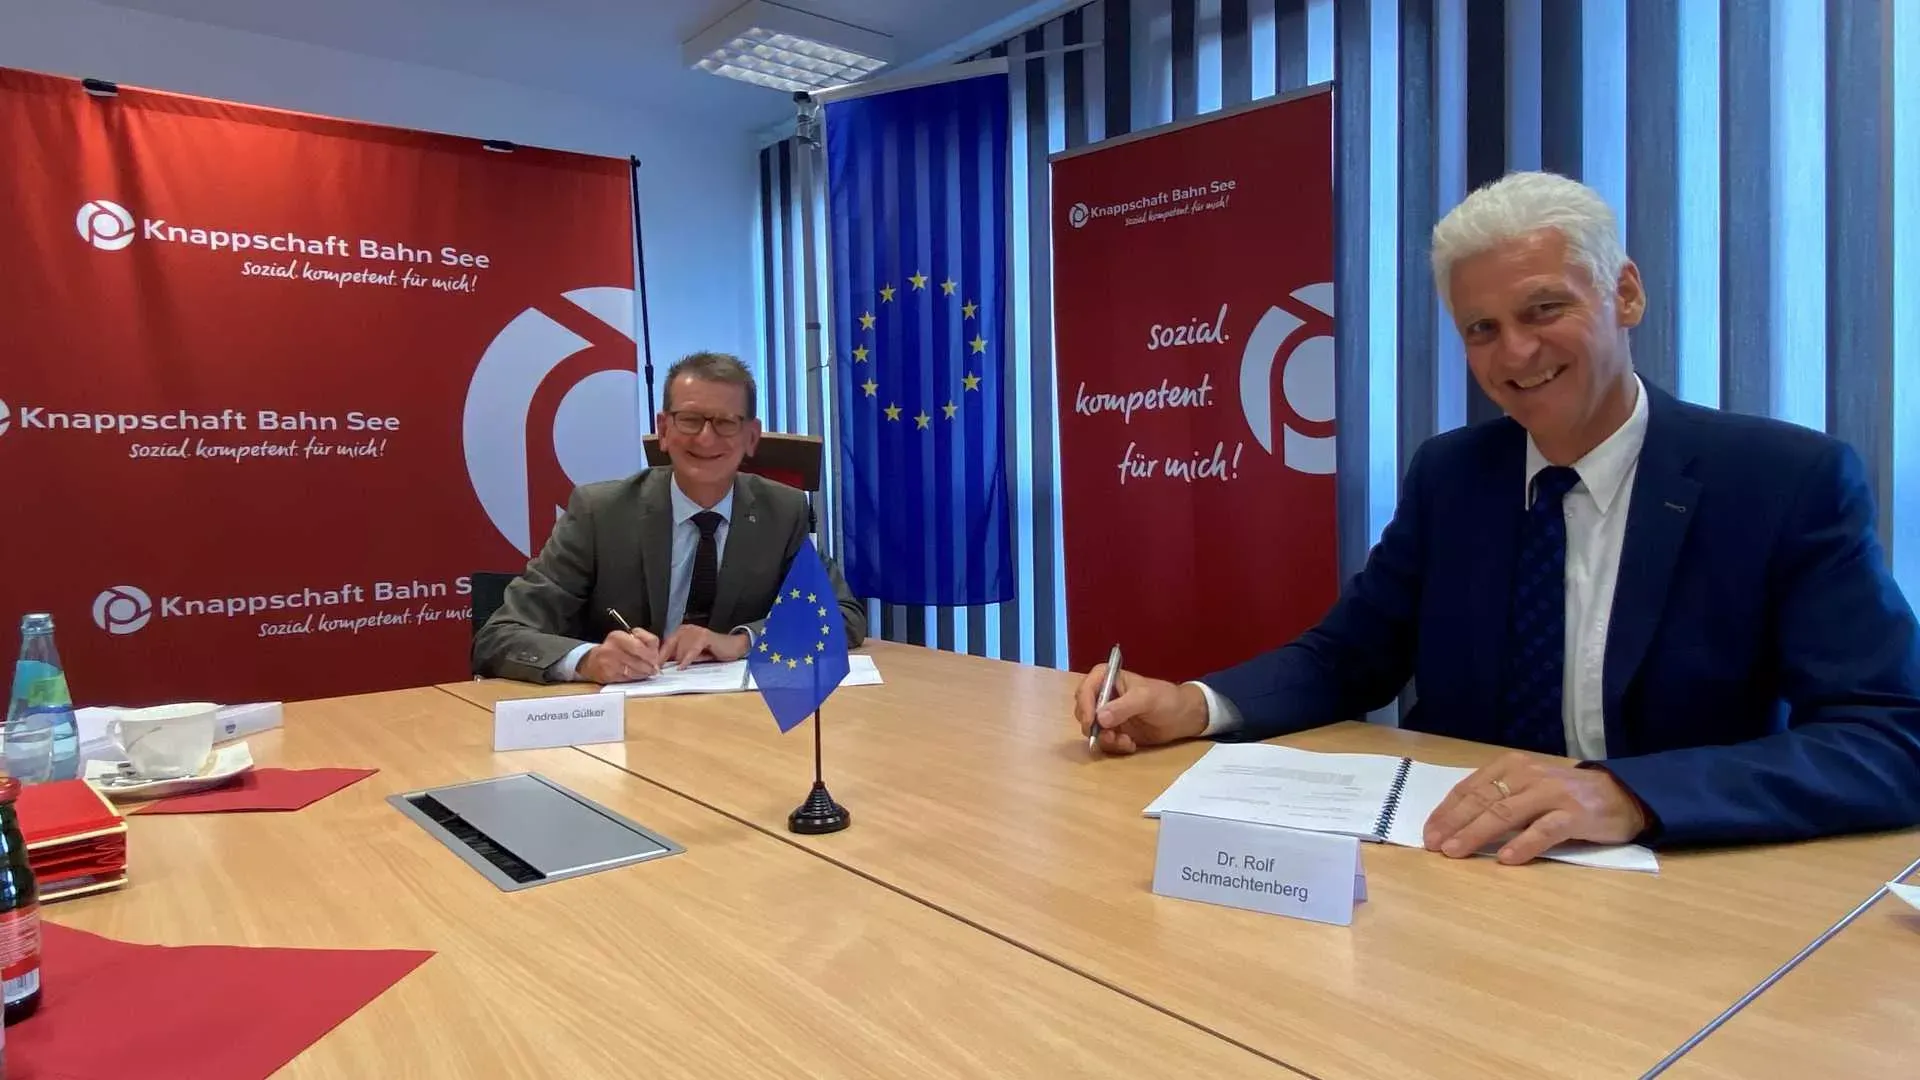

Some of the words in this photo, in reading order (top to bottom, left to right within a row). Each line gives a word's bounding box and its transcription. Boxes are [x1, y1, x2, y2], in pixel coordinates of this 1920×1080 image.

[1090, 191, 1169, 218] Knappschaft
[1172, 186, 1207, 201] Bahn
[1210, 180, 1237, 193] See
[143, 218, 350, 257] Knappschaft
[359, 239, 433, 263] Bahn
[440, 247, 490, 268] See
[402, 268, 429, 289] für
[432, 274, 478, 293] mich!
[1147, 303, 1230, 350] sozial.
[1075, 373, 1213, 424] kompetent.
[20, 406, 247, 434] Knappschaft
[258, 410, 337, 431] Bahn
[346, 411, 400, 431] See
[195, 438, 299, 464] kompetent.
[303, 436, 331, 459] für
[336, 438, 387, 459] mich!
[1118, 441, 1158, 485] für
[1165, 441, 1243, 483] mich!
[160, 584, 365, 618] Knappschaft
[374, 580, 447, 601] Bahn
[257, 613, 315, 638] sozial.
[318, 607, 413, 635] kompetent.
[416, 603, 441, 625] für
[446, 606, 473, 621] mic
[526, 711, 569, 722] Andreas
[1217, 851, 1239, 868] Dr.
[1244, 855, 1275, 872] Rolf
[1181, 867, 1309, 902] Schmachtenberg
